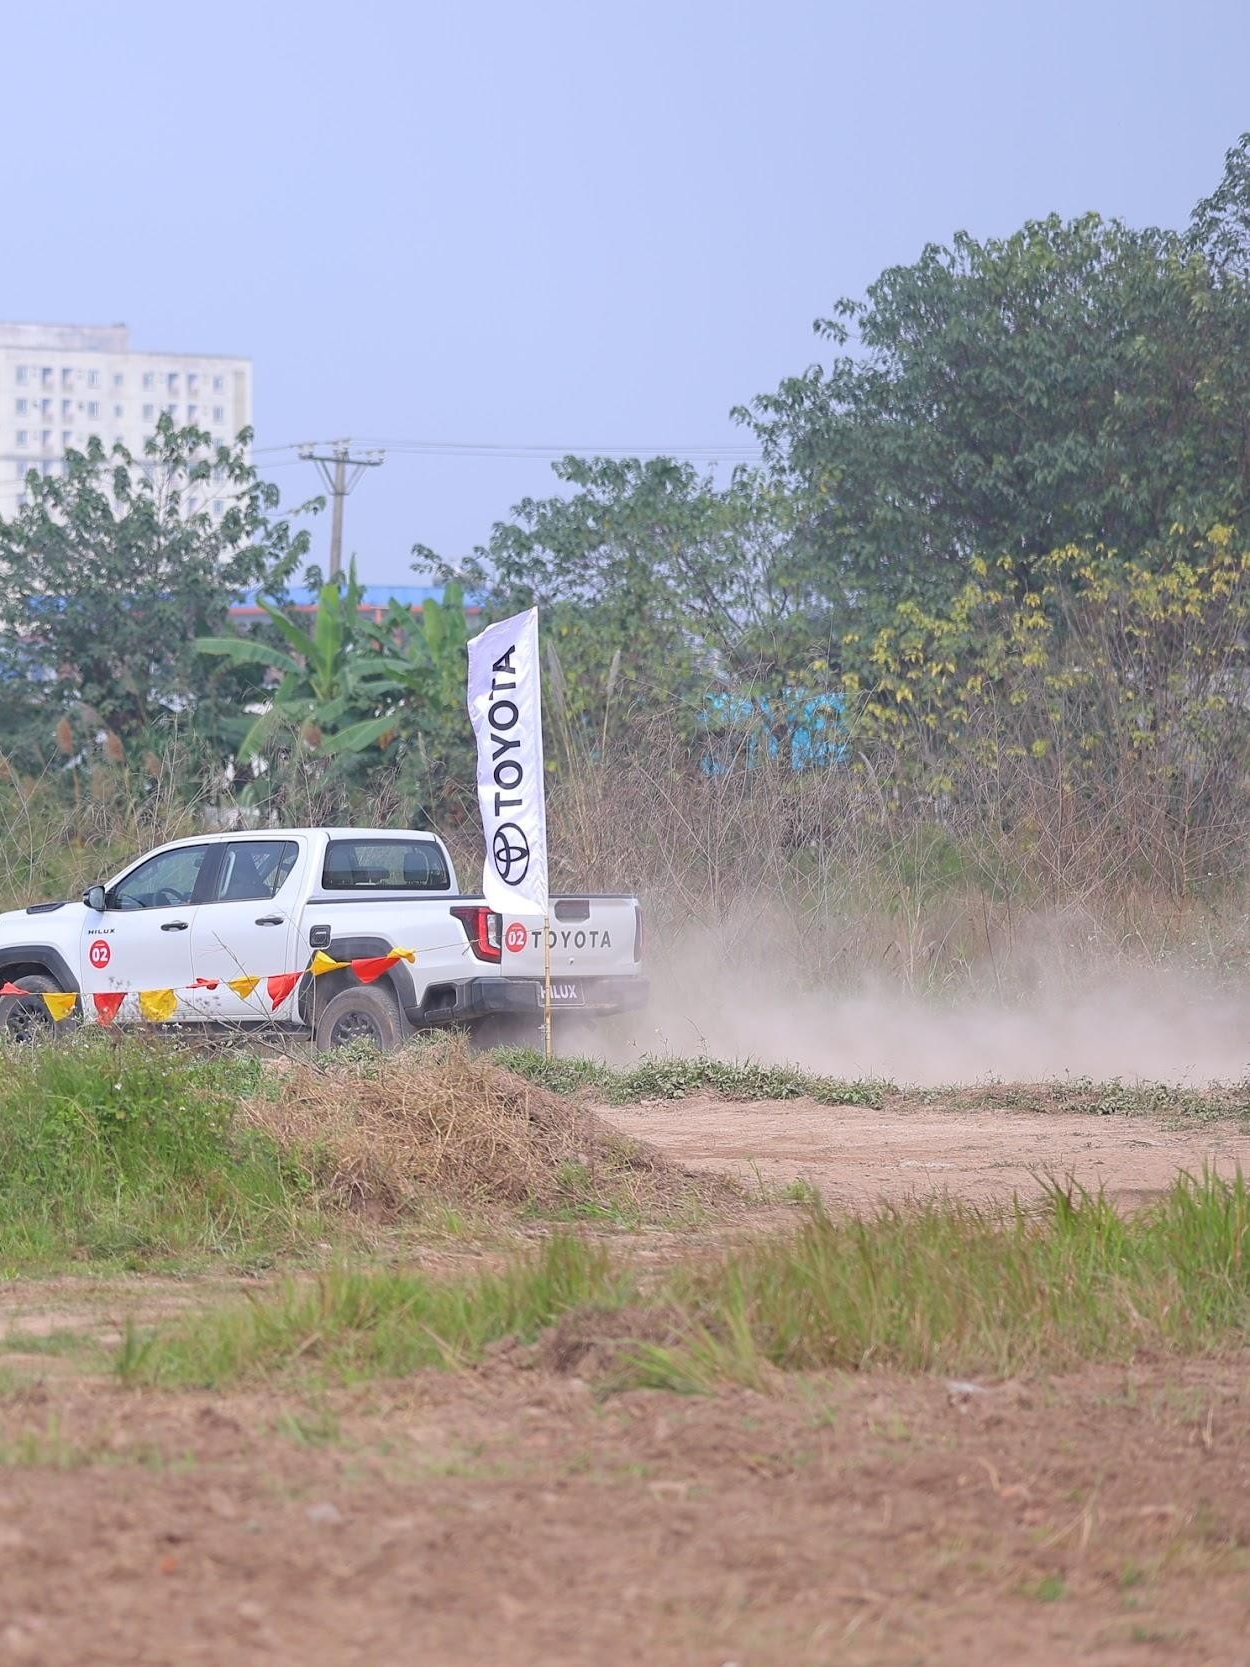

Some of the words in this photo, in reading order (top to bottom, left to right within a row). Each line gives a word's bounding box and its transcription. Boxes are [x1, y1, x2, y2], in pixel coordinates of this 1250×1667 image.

[488, 644, 523, 817] TOYOTA
[508, 931, 524, 946] 02
[532, 931, 611, 948] TOYOTA
[92, 947, 108, 962] 02
